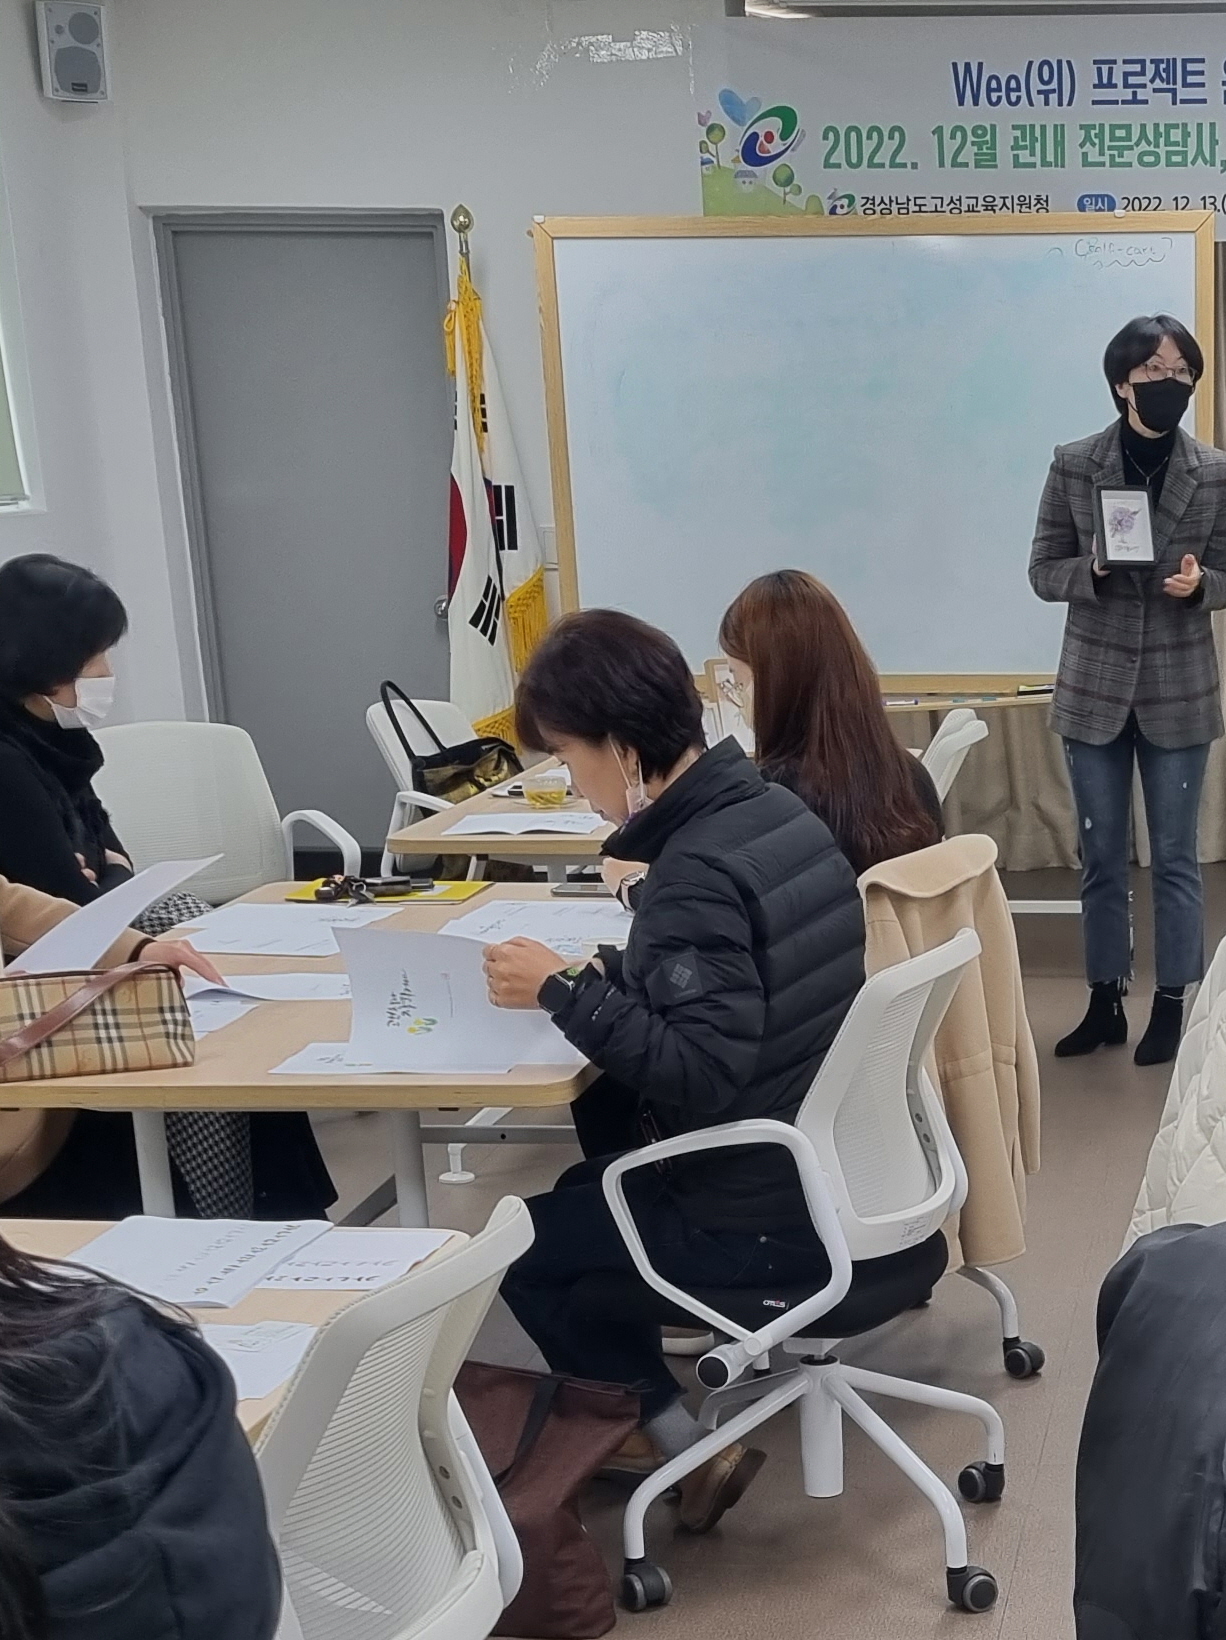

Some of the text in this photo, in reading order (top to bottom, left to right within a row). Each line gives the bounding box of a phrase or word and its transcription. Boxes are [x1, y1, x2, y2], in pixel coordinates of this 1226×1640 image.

[951, 58, 1076, 107] Wee(위)
[1091, 57, 1208, 106] 프로젝트
[822, 124, 919, 170] 2022.
[931, 123, 998, 169] 12월
[1010, 122, 1066, 169] 관내
[860, 194, 1050, 215] 경상남도고성교육지원청
[1082, 196, 1108, 211] 일시
